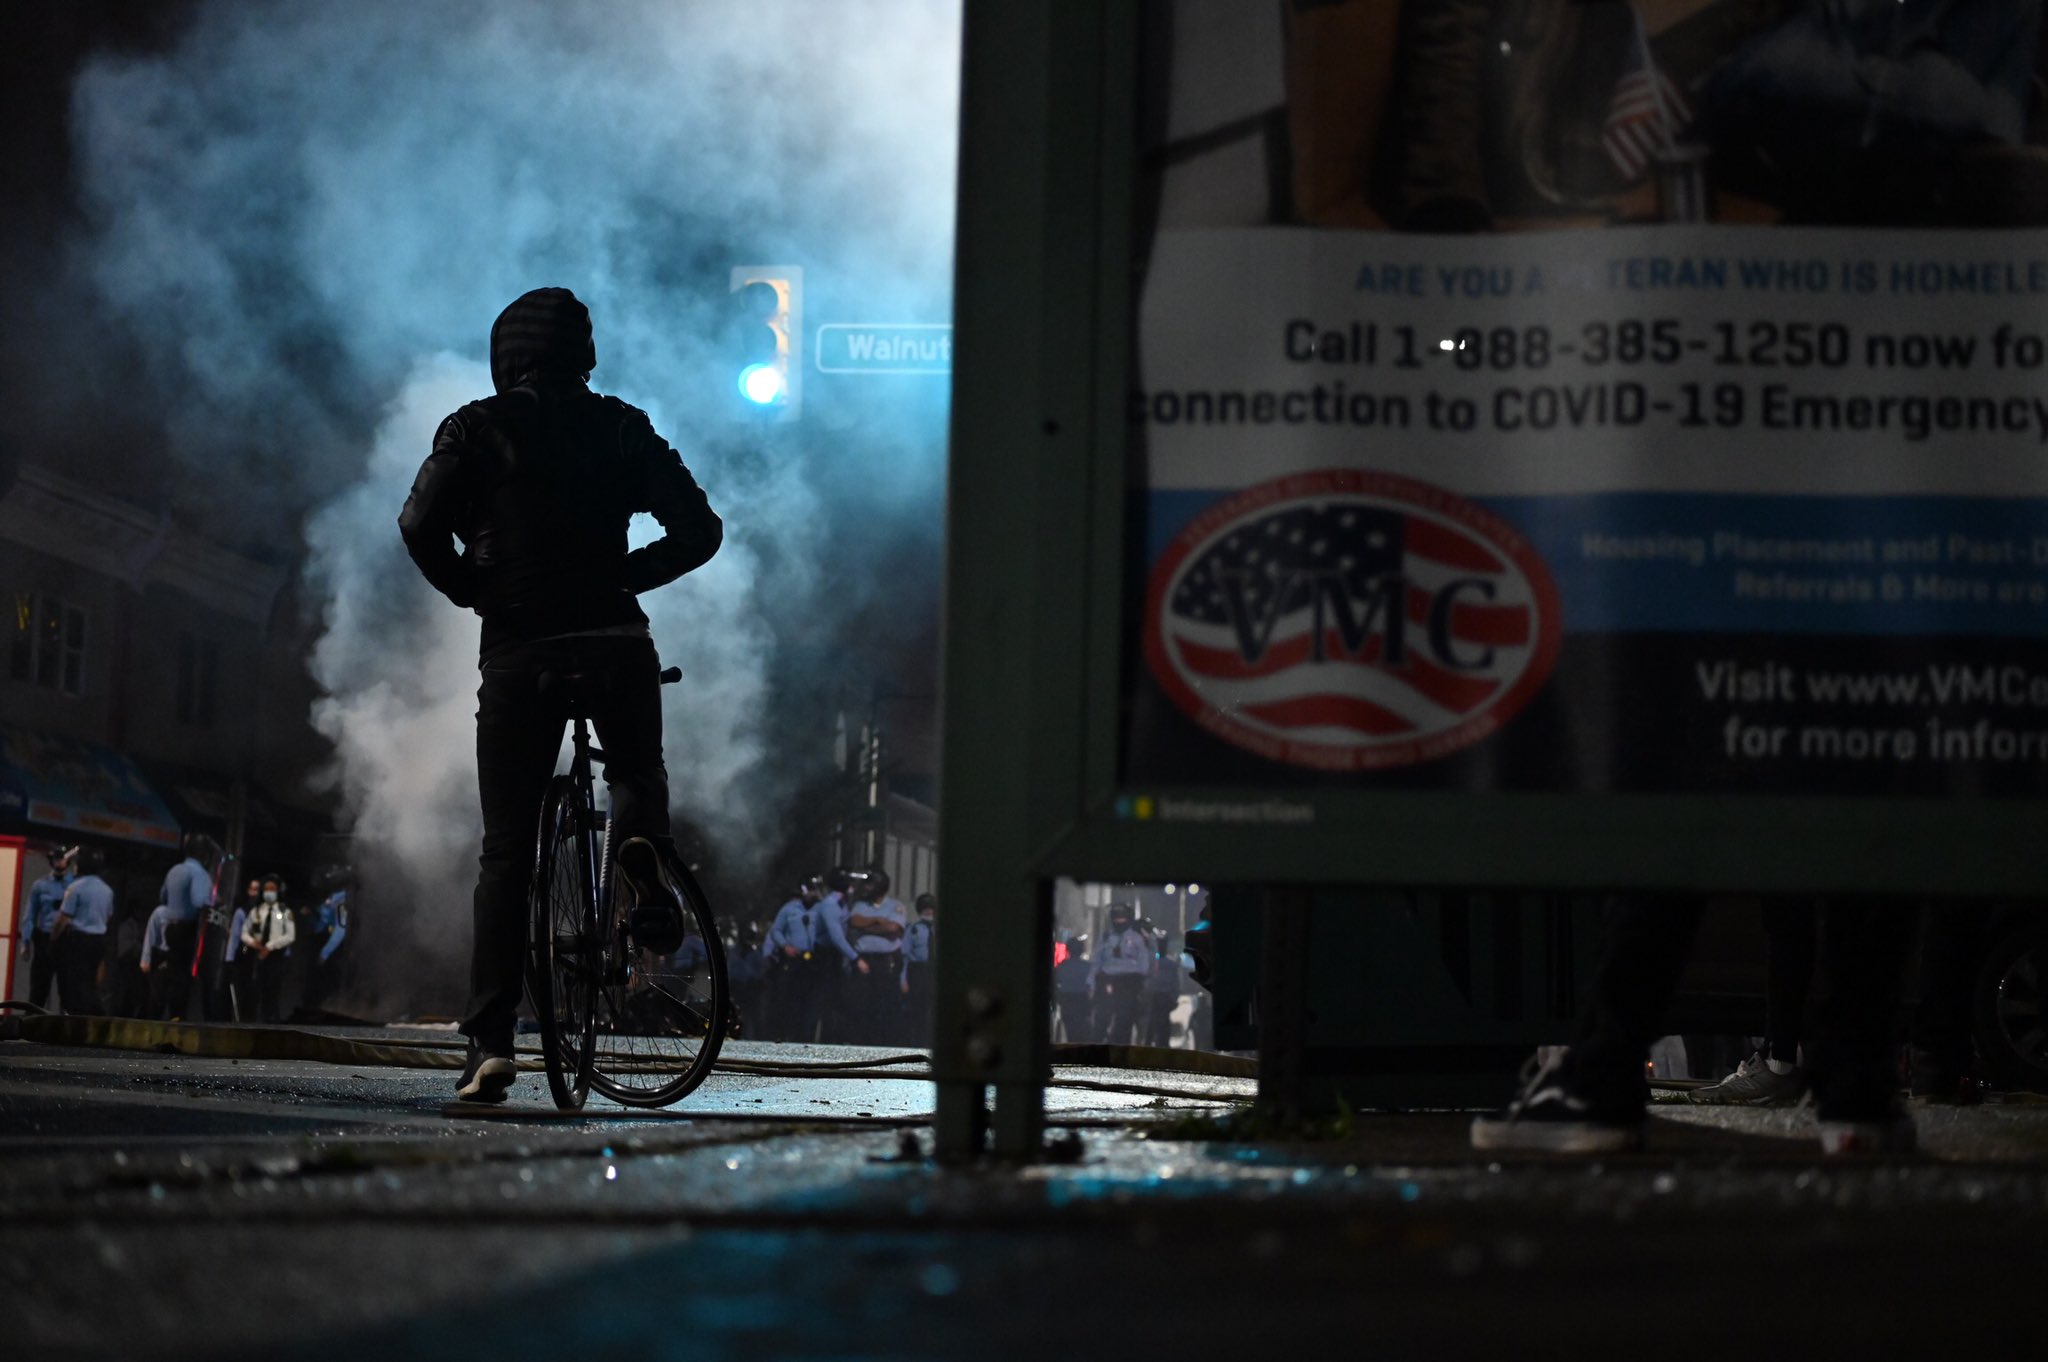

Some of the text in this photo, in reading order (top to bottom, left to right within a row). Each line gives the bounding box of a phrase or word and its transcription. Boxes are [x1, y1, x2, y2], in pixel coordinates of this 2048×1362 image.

[1355, 264, 1424, 296] ARE
[1439, 265, 1512, 298] YOU
[1739, 260, 1828, 292] WHO
[1842, 261, 1877, 293] IS
[847, 333, 951, 361] Walnut
[1284, 319, 1377, 363] Call
[1393, 320, 1849, 370] 1-888-385-1250
[1866, 334, 1976, 369] now
[1425, 390, 1476, 430] to
[1494, 381, 1743, 430] COVID-19
[1762, 383, 2048, 444] Emergency
[1581, 532, 1706, 566] Housing
[1712, 531, 1876, 563] Placement
[1882, 534, 1939, 563] and
[1732, 570, 1875, 600] Referrals
[1912, 572, 1990, 603] More
[1997, 580, 2047, 604] are
[1212, 567, 1498, 671] VMC
[1695, 659, 1797, 702] Visit
[1723, 715, 1790, 760] for
[1800, 726, 1919, 761] more
